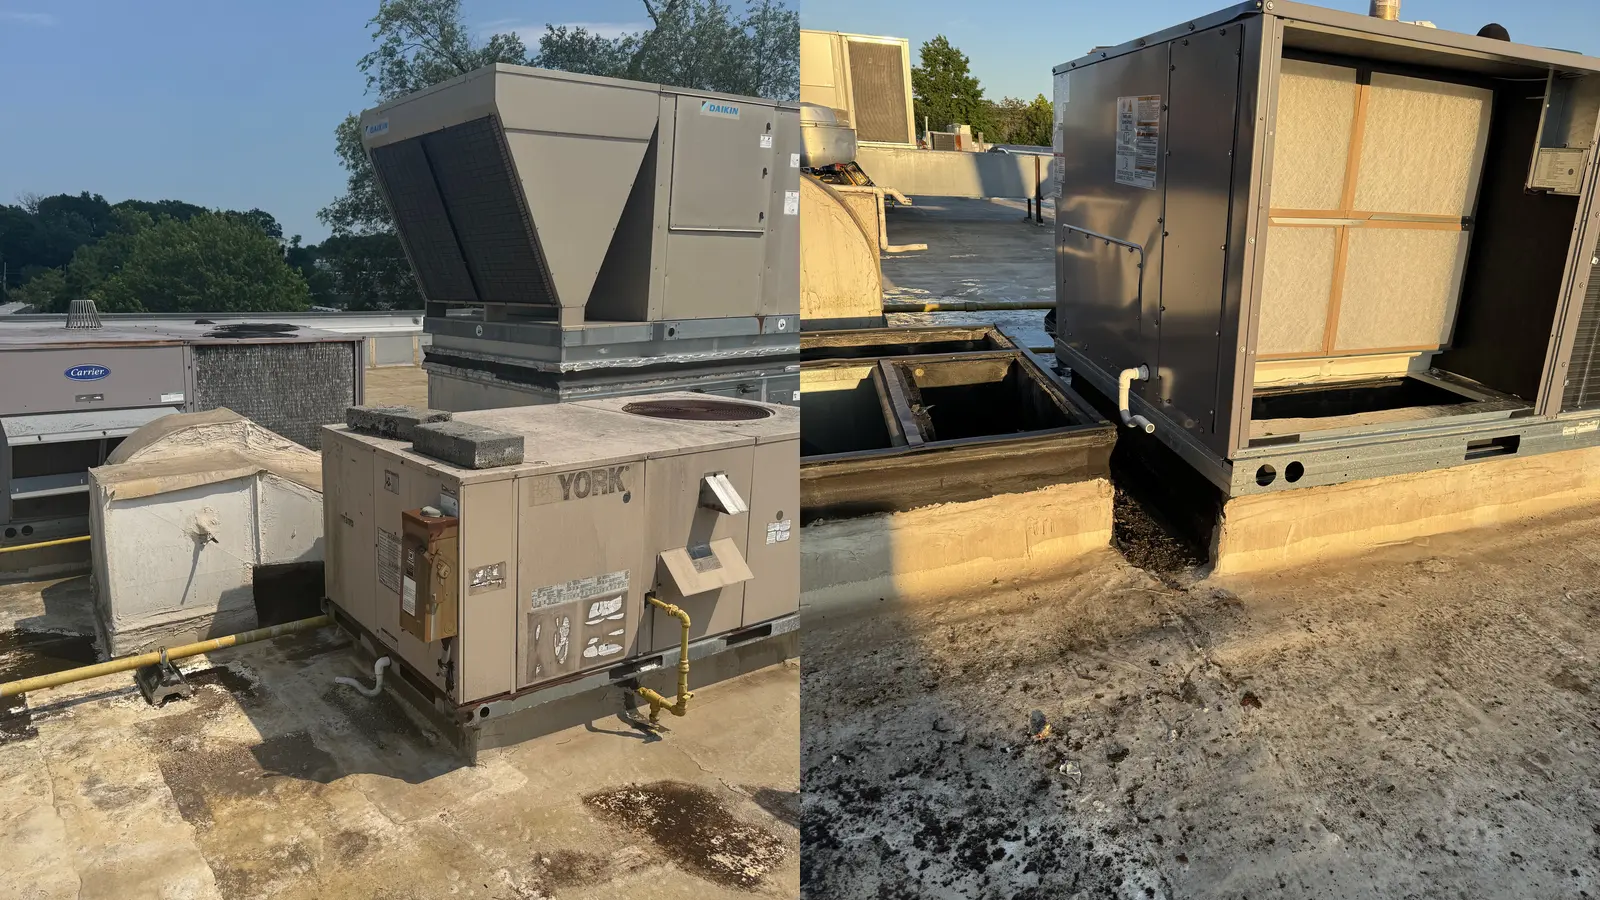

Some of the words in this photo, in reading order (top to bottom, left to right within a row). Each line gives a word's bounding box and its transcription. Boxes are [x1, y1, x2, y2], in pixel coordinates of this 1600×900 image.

[709, 104, 739, 115] DAIKIN
[70, 368, 105, 377] Carrier
[557, 466, 626, 501] YORK
